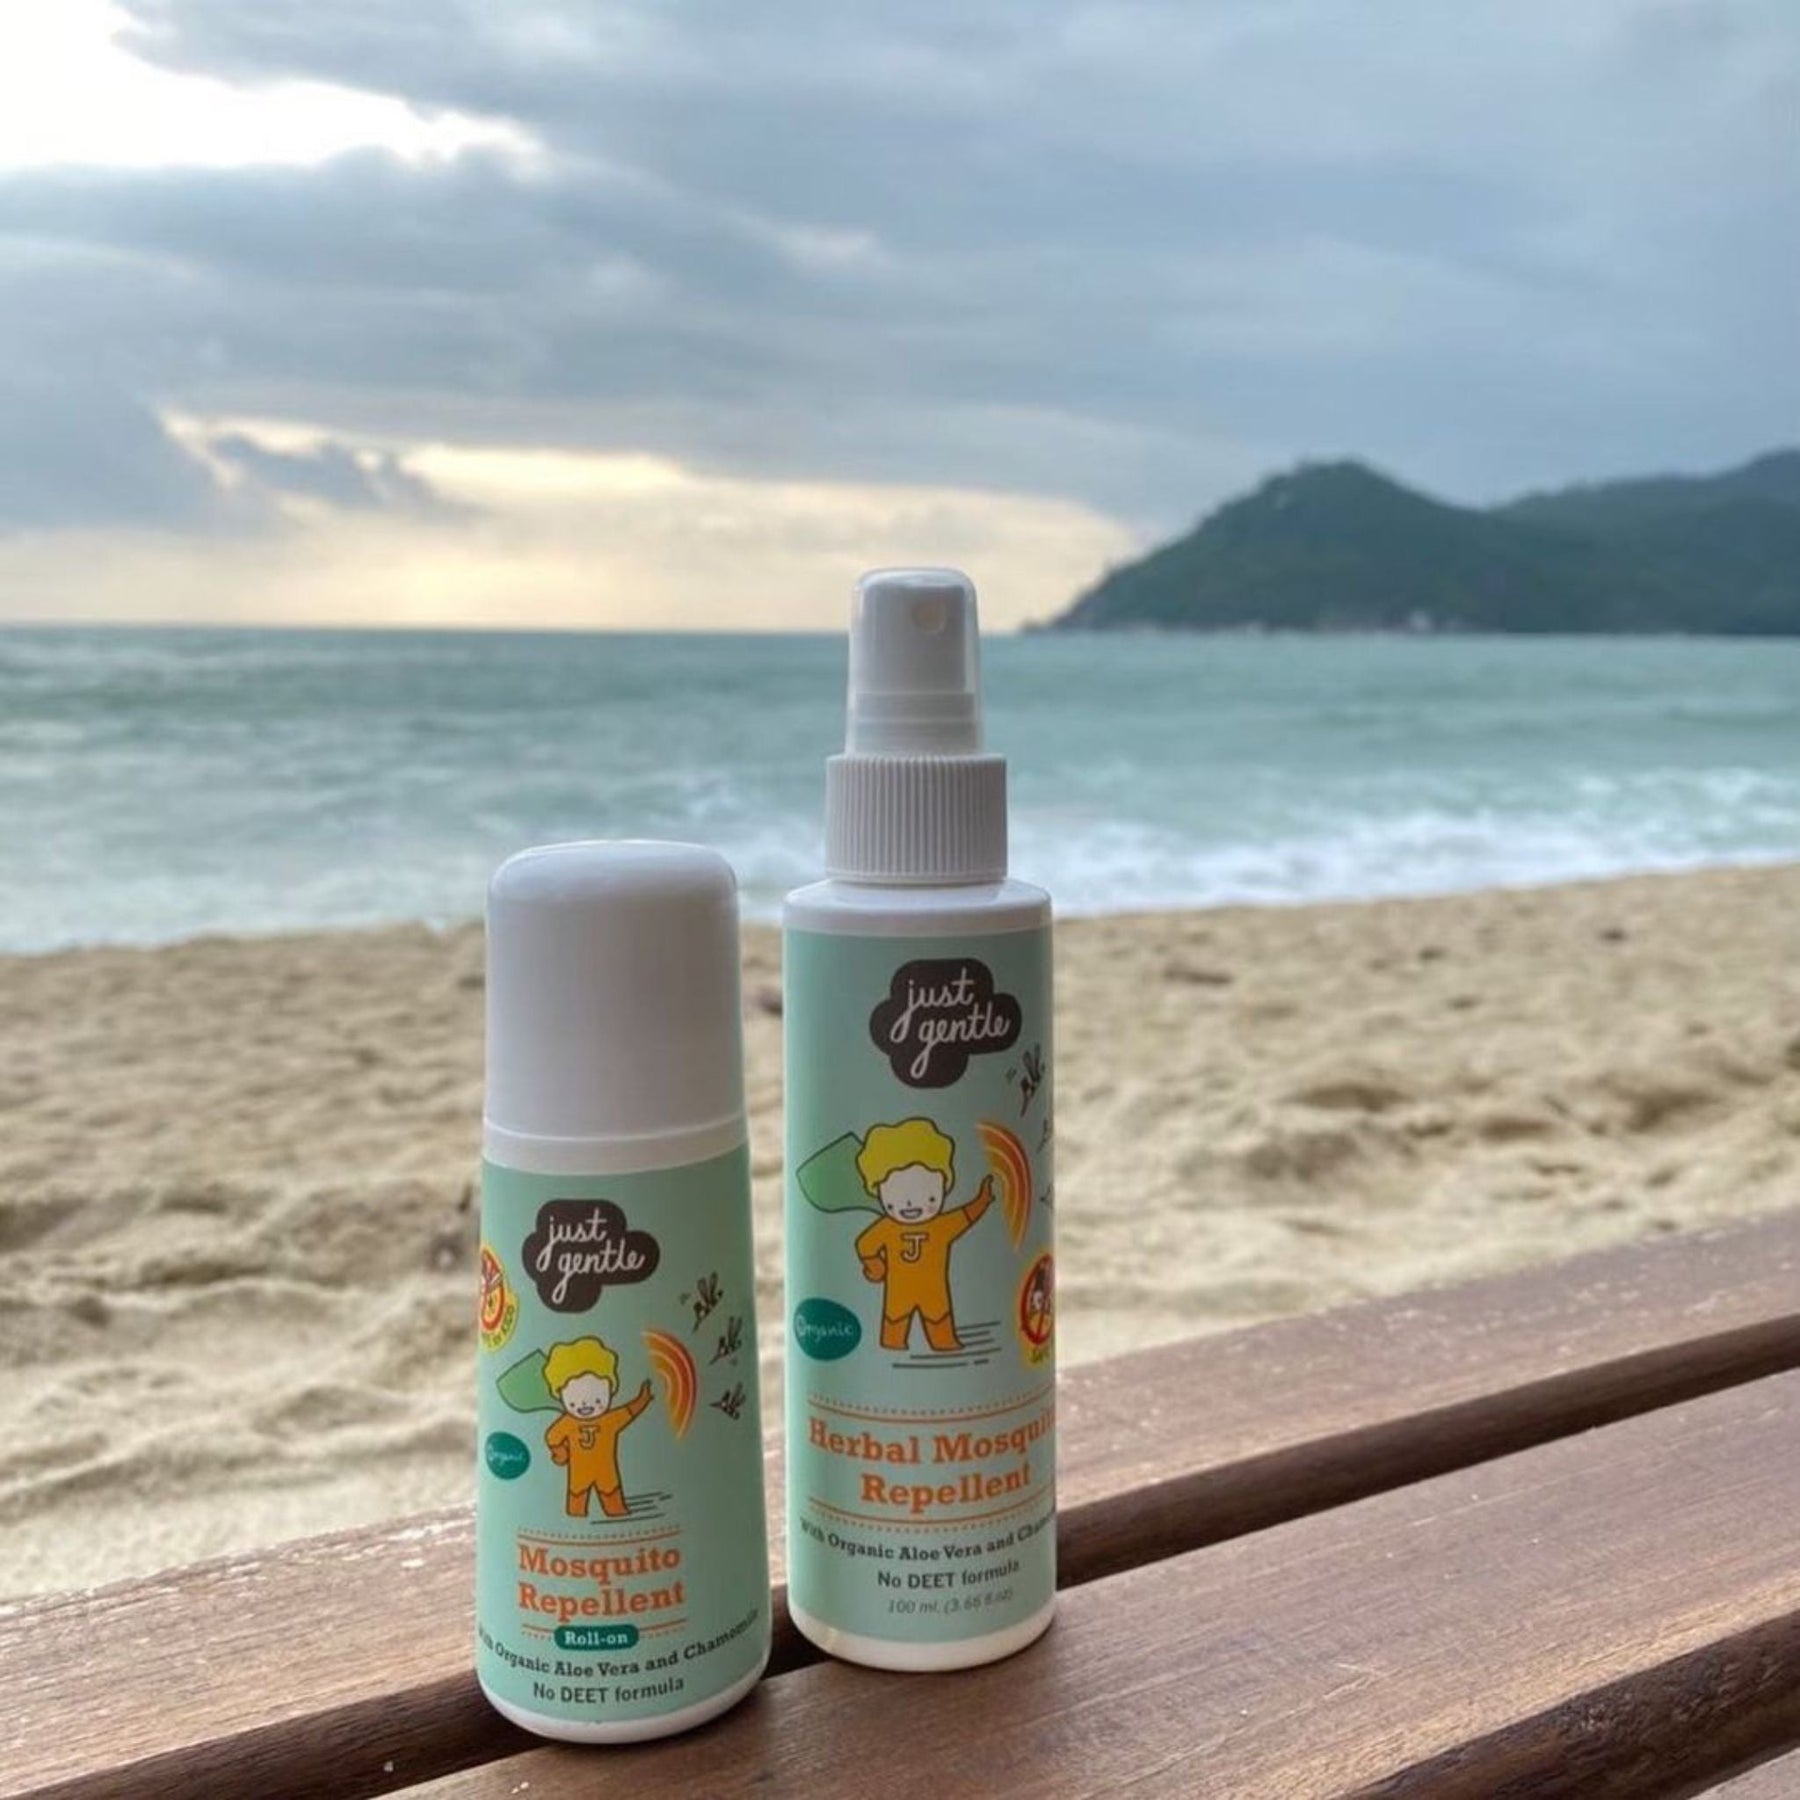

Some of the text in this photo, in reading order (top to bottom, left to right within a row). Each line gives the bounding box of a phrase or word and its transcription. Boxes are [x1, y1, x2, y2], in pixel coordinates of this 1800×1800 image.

[890, 967, 974, 1044] just
[910, 1001, 1011, 1080] gentle
[536, 1207, 607, 1272] just
[901, 1232, 929, 1263] J
[551, 1238, 646, 1304] gentle
[796, 1313, 853, 1343] Organic
[809, 1416, 921, 1464] Herbal
[861, 1461, 1034, 1514] Repellent
[518, 1544, 681, 1585] Mosquito
[828, 1532, 894, 1560] Organic
[900, 1545, 940, 1561] Aloe
[943, 1544, 982, 1560] Vera
[987, 1531, 1015, 1551] and
[878, 1558, 1020, 1589] No DEET formula
[518, 1580, 686, 1623] Repellent
[888, 1599, 916, 1615] 100
[564, 1630, 628, 1647] Roll-on
[494, 1641, 550, 1674] Organic
[554, 1660, 593, 1678] Aloe
[598, 1661, 640, 1678] Vera
[645, 1650, 679, 1667] and
[533, 1676, 685, 1704] No DEET formula
